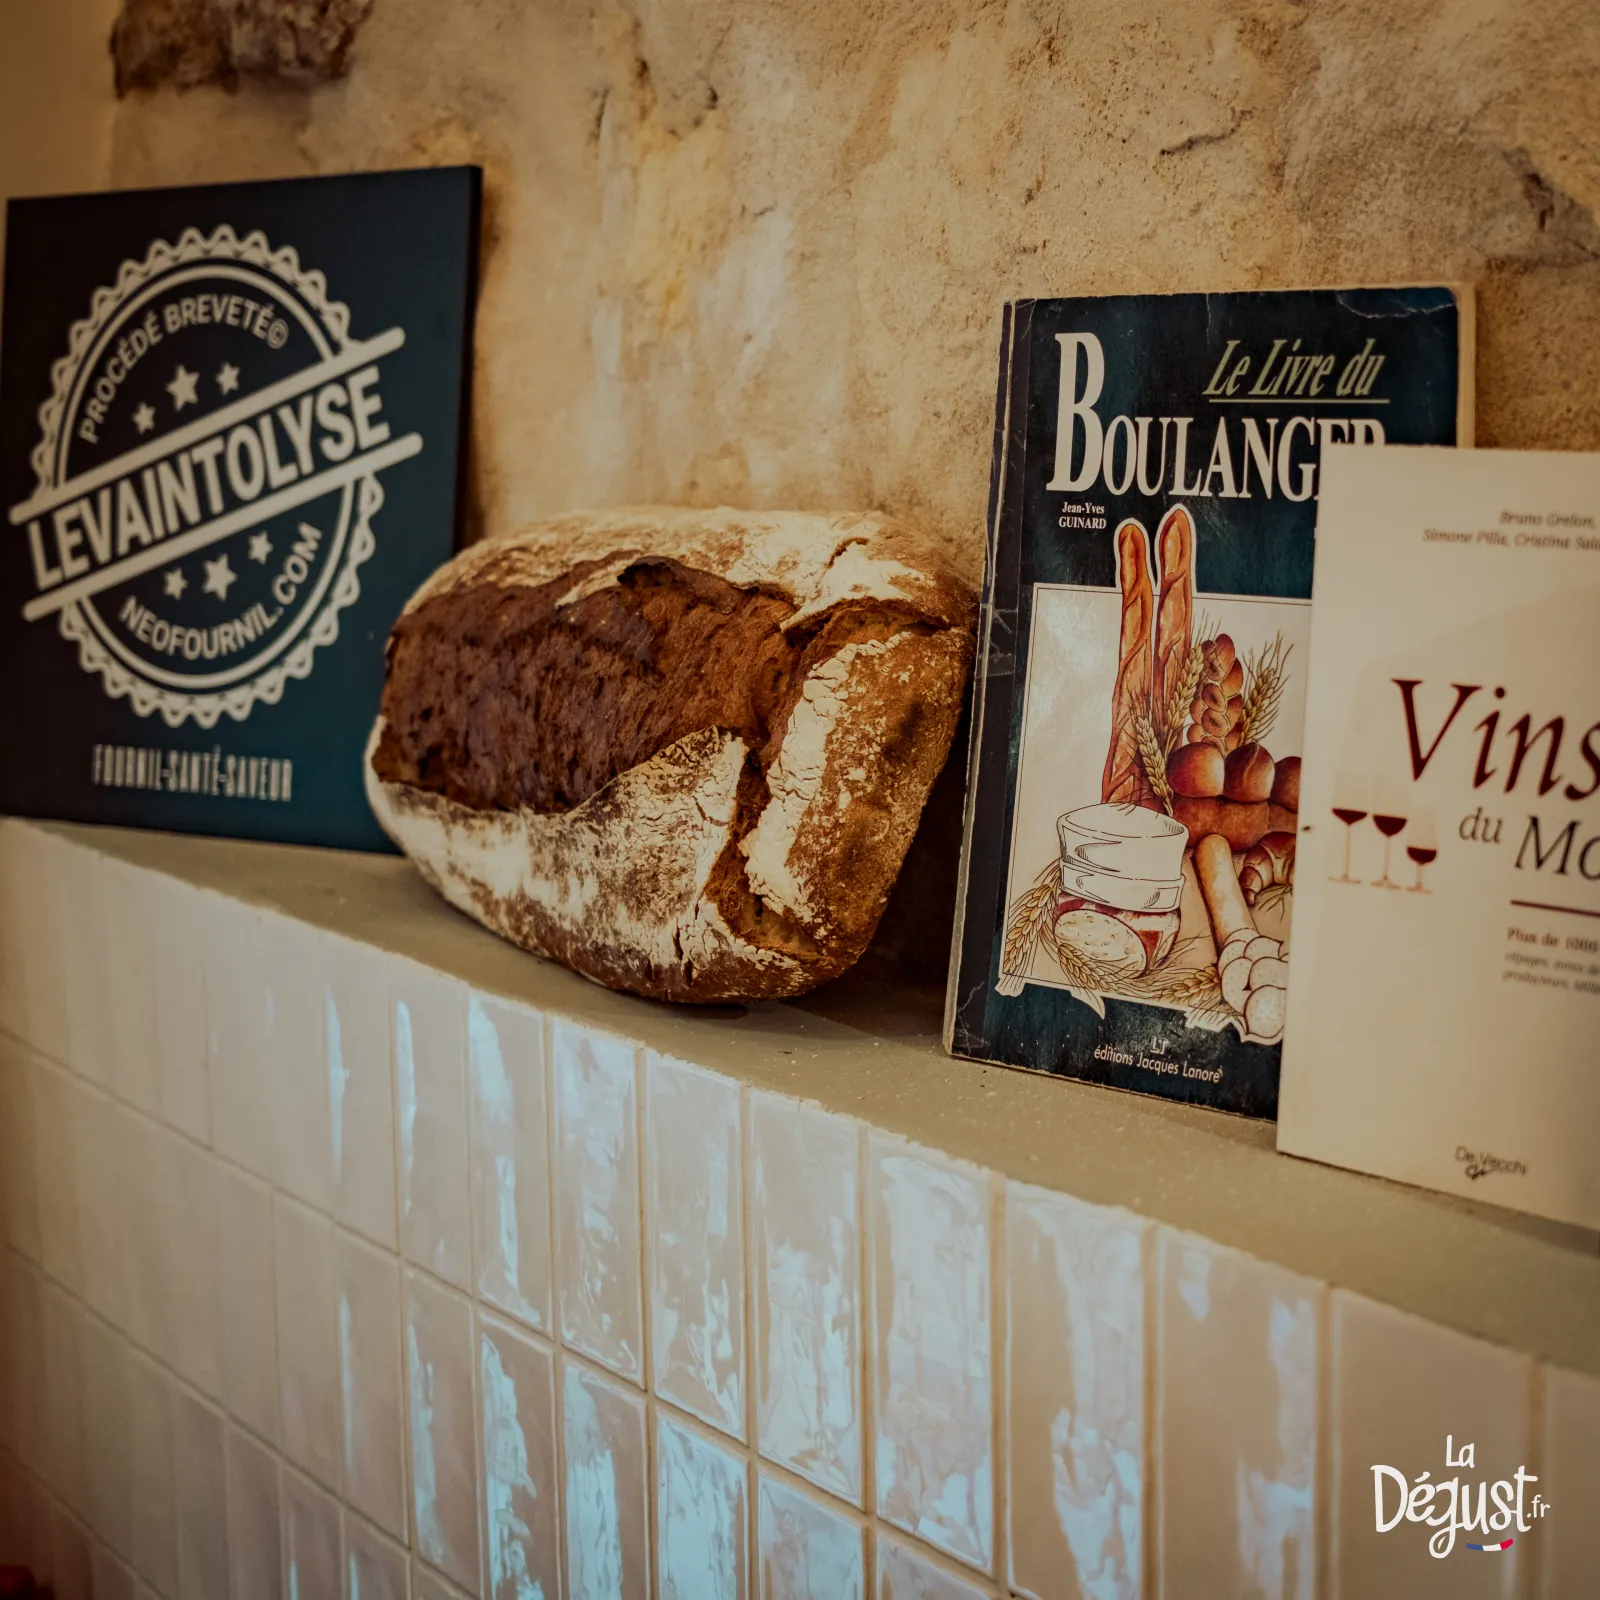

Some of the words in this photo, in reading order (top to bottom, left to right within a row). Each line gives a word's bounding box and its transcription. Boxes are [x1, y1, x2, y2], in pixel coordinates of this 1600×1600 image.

[77, 310, 163, 444] PROCÉDÉ
[1202, 340, 1251, 396] Le
[1248, 338, 1336, 396] Livre
[1336, 338, 1386, 396] du
[27, 365, 391, 590] LEVAINTOLYSE
[1058, 516, 1107, 529] GUINARD
[1062, 501, 1105, 515] Jean-Yves
[1499, 510, 1542, 526] Bruno
[1422, 528, 1472, 544] Simone
[1514, 532, 1570, 549] Cristina
[1390, 678, 1600, 801] Vins
[1458, 806, 1503, 844] du
[1094, 1045, 1133, 1066] éditions
[1136, 1052, 1179, 1075] Jacques
[1455, 1145, 1475, 1161] De
[1480, 1152, 1527, 1176] Vecchi
